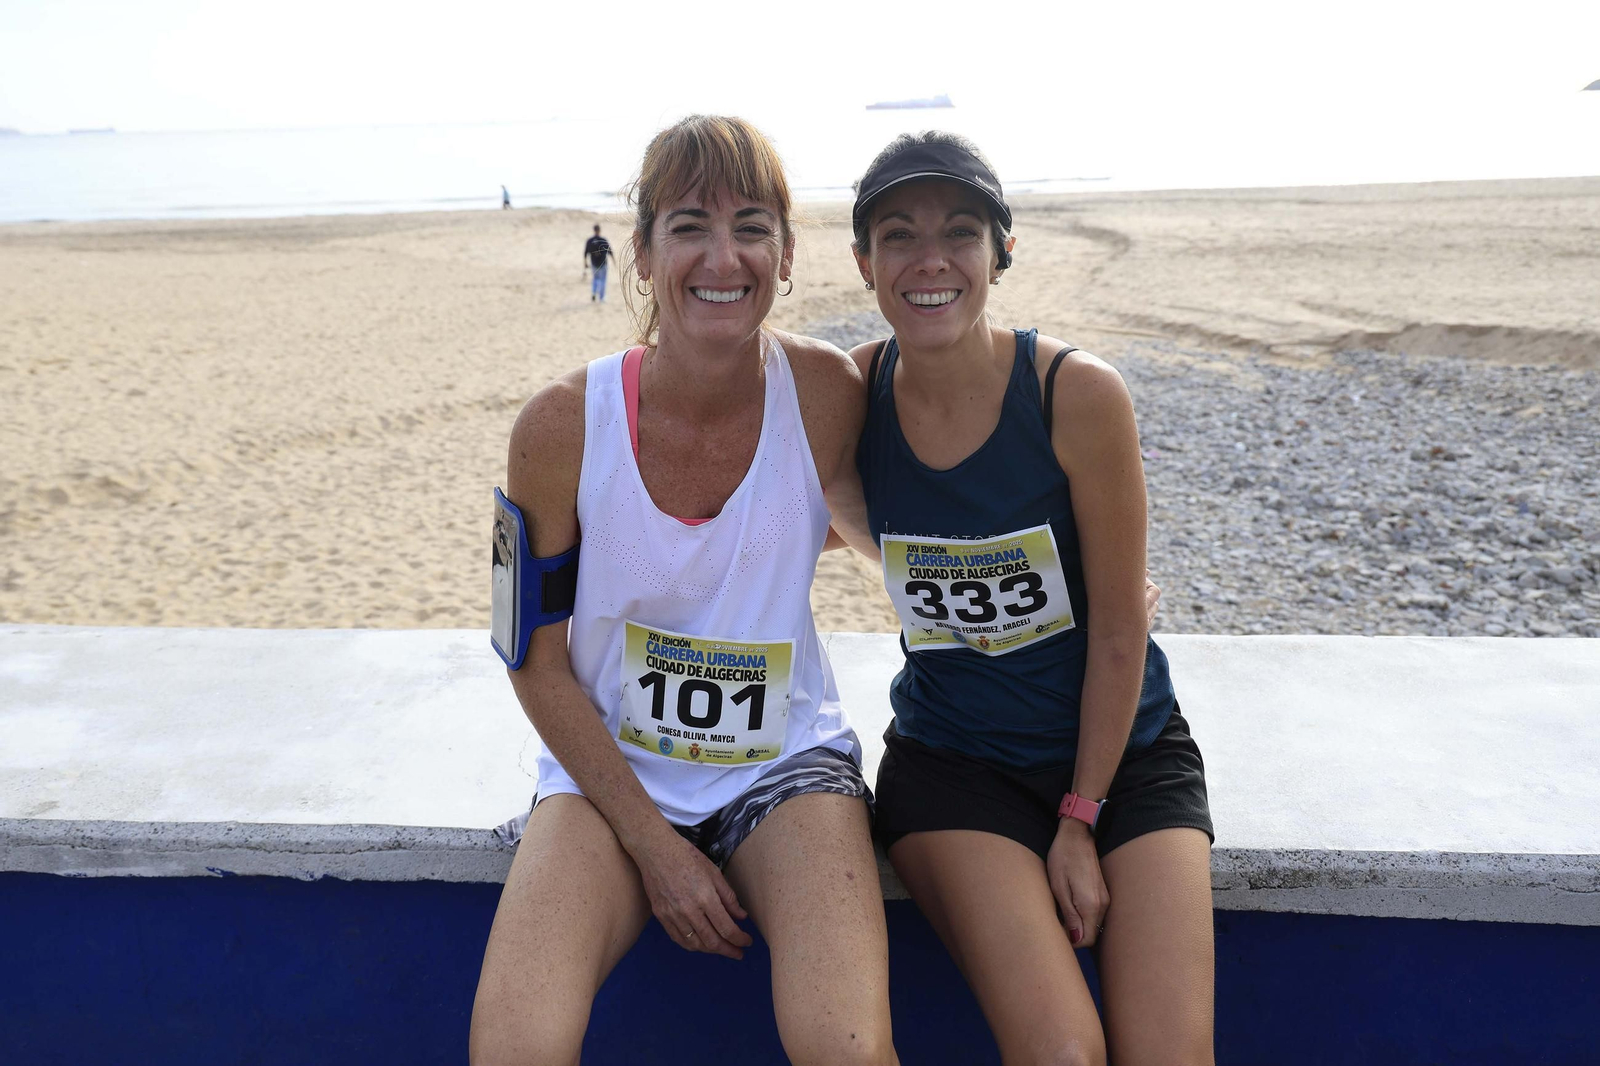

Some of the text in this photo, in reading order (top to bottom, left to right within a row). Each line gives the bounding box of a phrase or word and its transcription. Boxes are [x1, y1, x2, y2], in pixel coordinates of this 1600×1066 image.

[906, 545, 947, 555] XXV EDICIÓN
[906, 547, 1027, 567] CARRERA URBANA
[909, 561, 1030, 580] CIUDAD DE ALGECIRAS
[905, 572, 1048, 623] 333
[961, 625, 1001, 635] FERNÁNDEZ,
[1003, 618, 1031, 631] ARACELI
[648, 632, 691, 648] XXV EDICIÓN
[646, 640, 767, 668] CARRERA URBANA
[646, 655, 766, 682] CIUDAD DE ALGECIRAS
[638, 670, 766, 731] 101
[657, 725, 735, 744] CONESA OLLIVA, MAYCA
